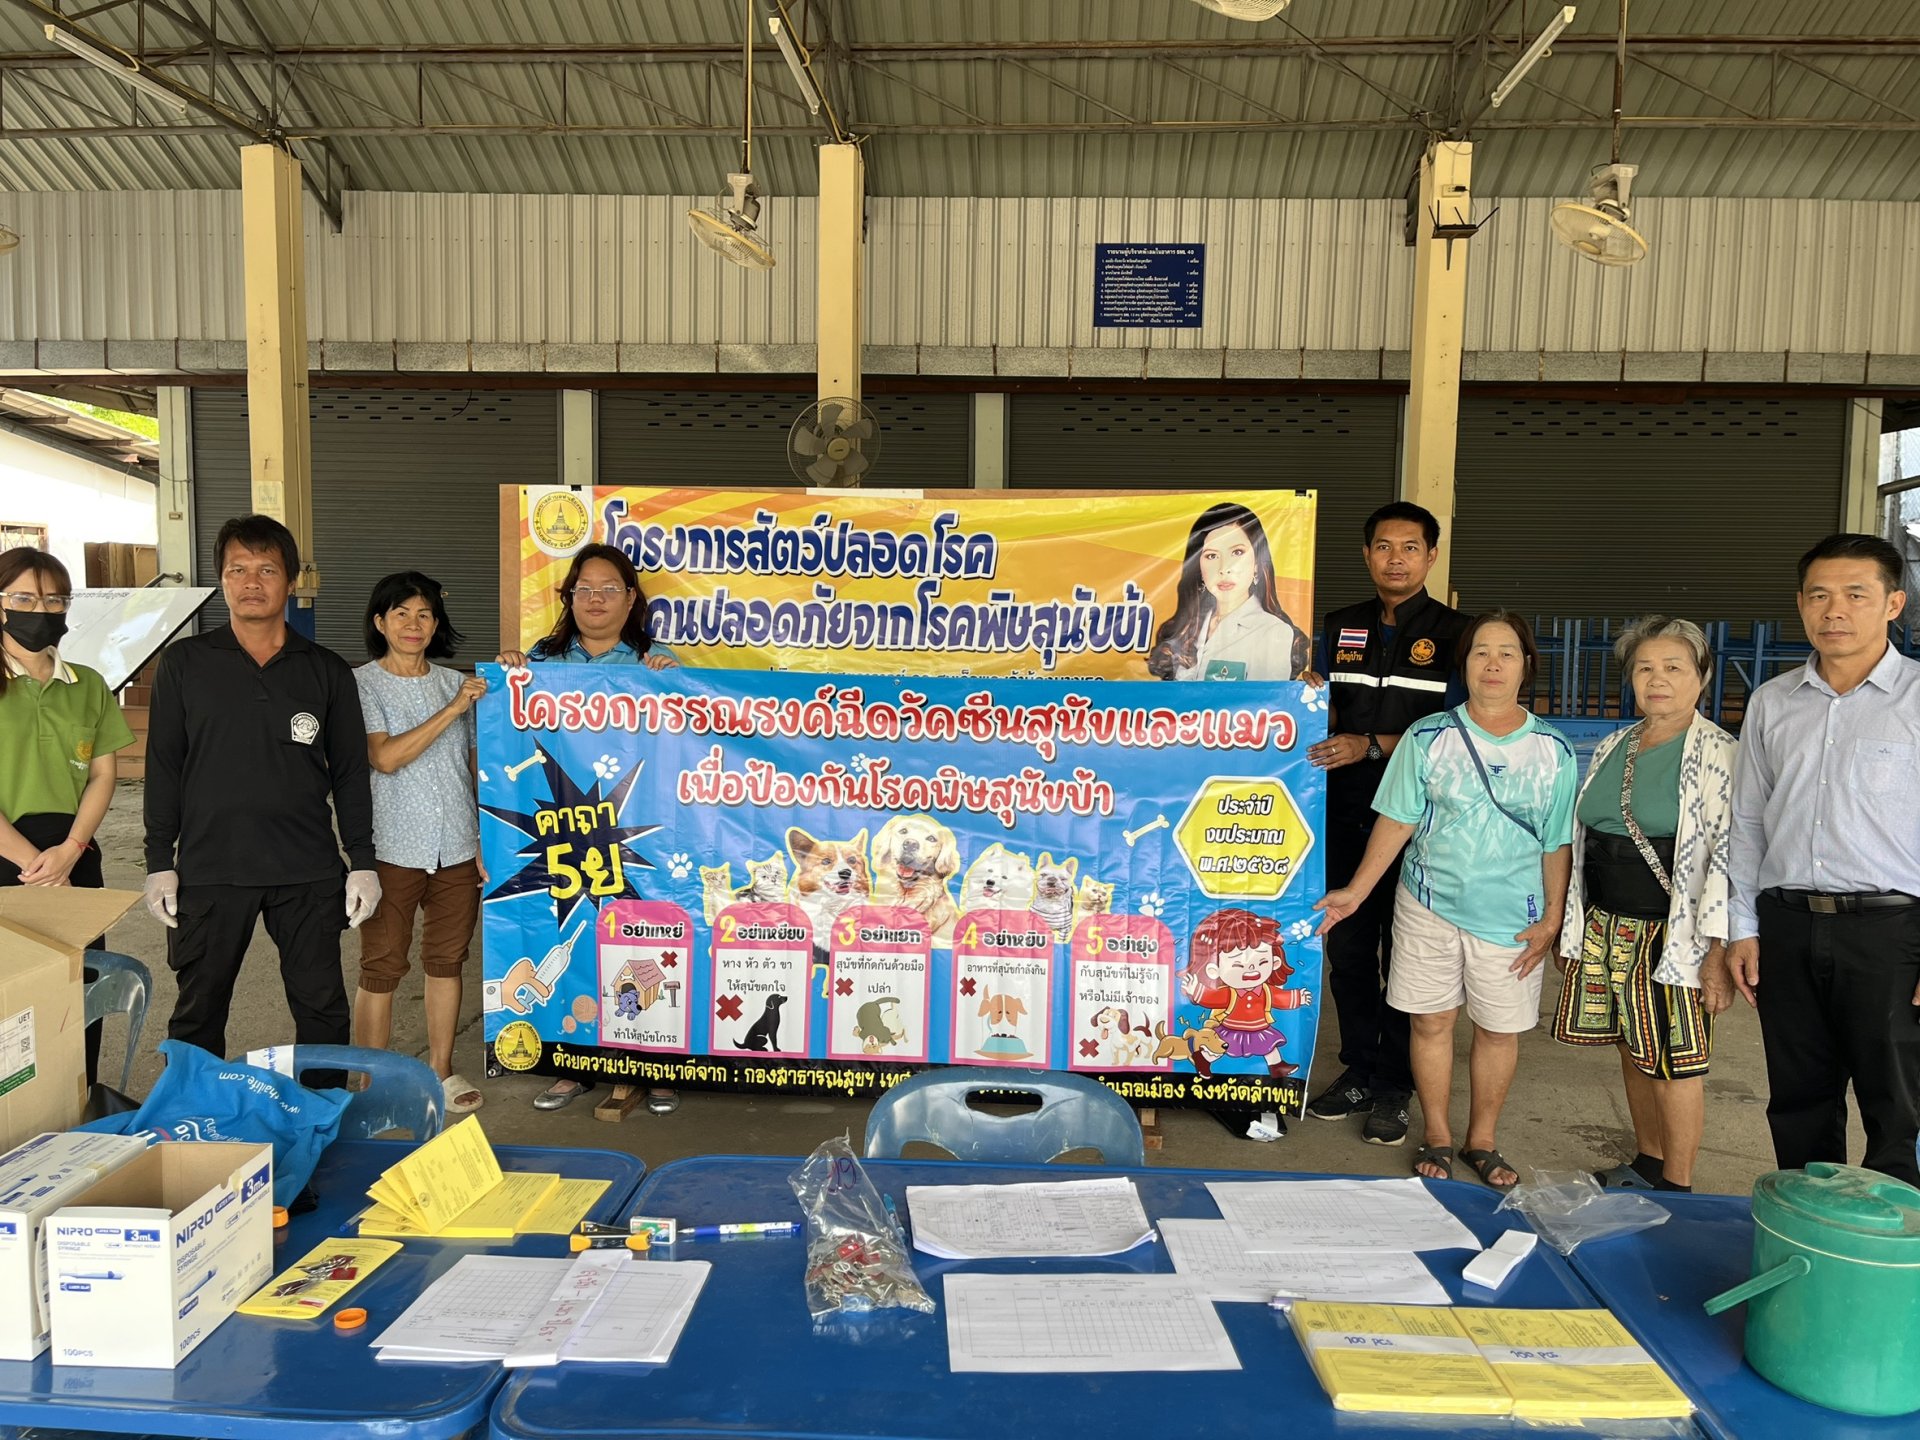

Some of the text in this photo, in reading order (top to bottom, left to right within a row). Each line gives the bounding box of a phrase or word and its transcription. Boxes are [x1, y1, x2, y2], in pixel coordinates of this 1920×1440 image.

[508, 669, 1295, 758] โครงการรณรงค์ฉีดวัคซีนสุนัขและแมว
[679, 748, 1113, 825] เพื่อป้องกันโรคพิษสุนัขบ้า
[1218, 795, 1273, 815] ประจำปี
[535, 801, 617, 836] คาถา
[1205, 825, 1284, 845] งบประมาณ
[1199, 857, 1289, 875] พ.ศ.๒๕๖๘
[604, 911, 684, 938] 1 อย่าแหย่
[719, 914, 736, 942] 2
[838, 916, 921, 946] 3 อย่าแยก
[961, 922, 1046, 949] 4 อย่าหยิบ
[1085, 926, 1158, 958] 5 อย่ายุ่ง
[722, 956, 792, 969] หาง หัว ตัว ขา
[836, 956, 924, 975] สุนัขที่กัดกันด้วยมือ
[967, 962, 1046, 979] อาหารที่สุนัขกำลังกิน
[1079, 965, 1160, 984] กับสุนัขที่ไม่รู้จัก
[726, 978, 787, 996] ให้สุนัขตกใจ
[867, 982, 892, 994] เปล่า
[1079, 989, 1159, 1005] หรือไม่มีเจ้าของ
[613, 1028, 678, 1044] ทำให้สุนัขโกรธ
[552, 1044, 728, 1083] ด้วยความปรารถนาดีจาก
[1190, 1077, 1299, 1114] จังหวัดลำพูน
[175, 1208, 214, 1249] NIPRO
[246, 1177, 265, 1198] 3mL
[56, 1227, 94, 1237] NIPRO
[130, 1230, 154, 1242] 3mL
[176, 1238, 207, 1267] DISPOSABLE
[176, 1252, 199, 1274] SYRINGE
[1345, 1335, 1366, 1345] 100
[1510, 1350, 1534, 1359] 100
